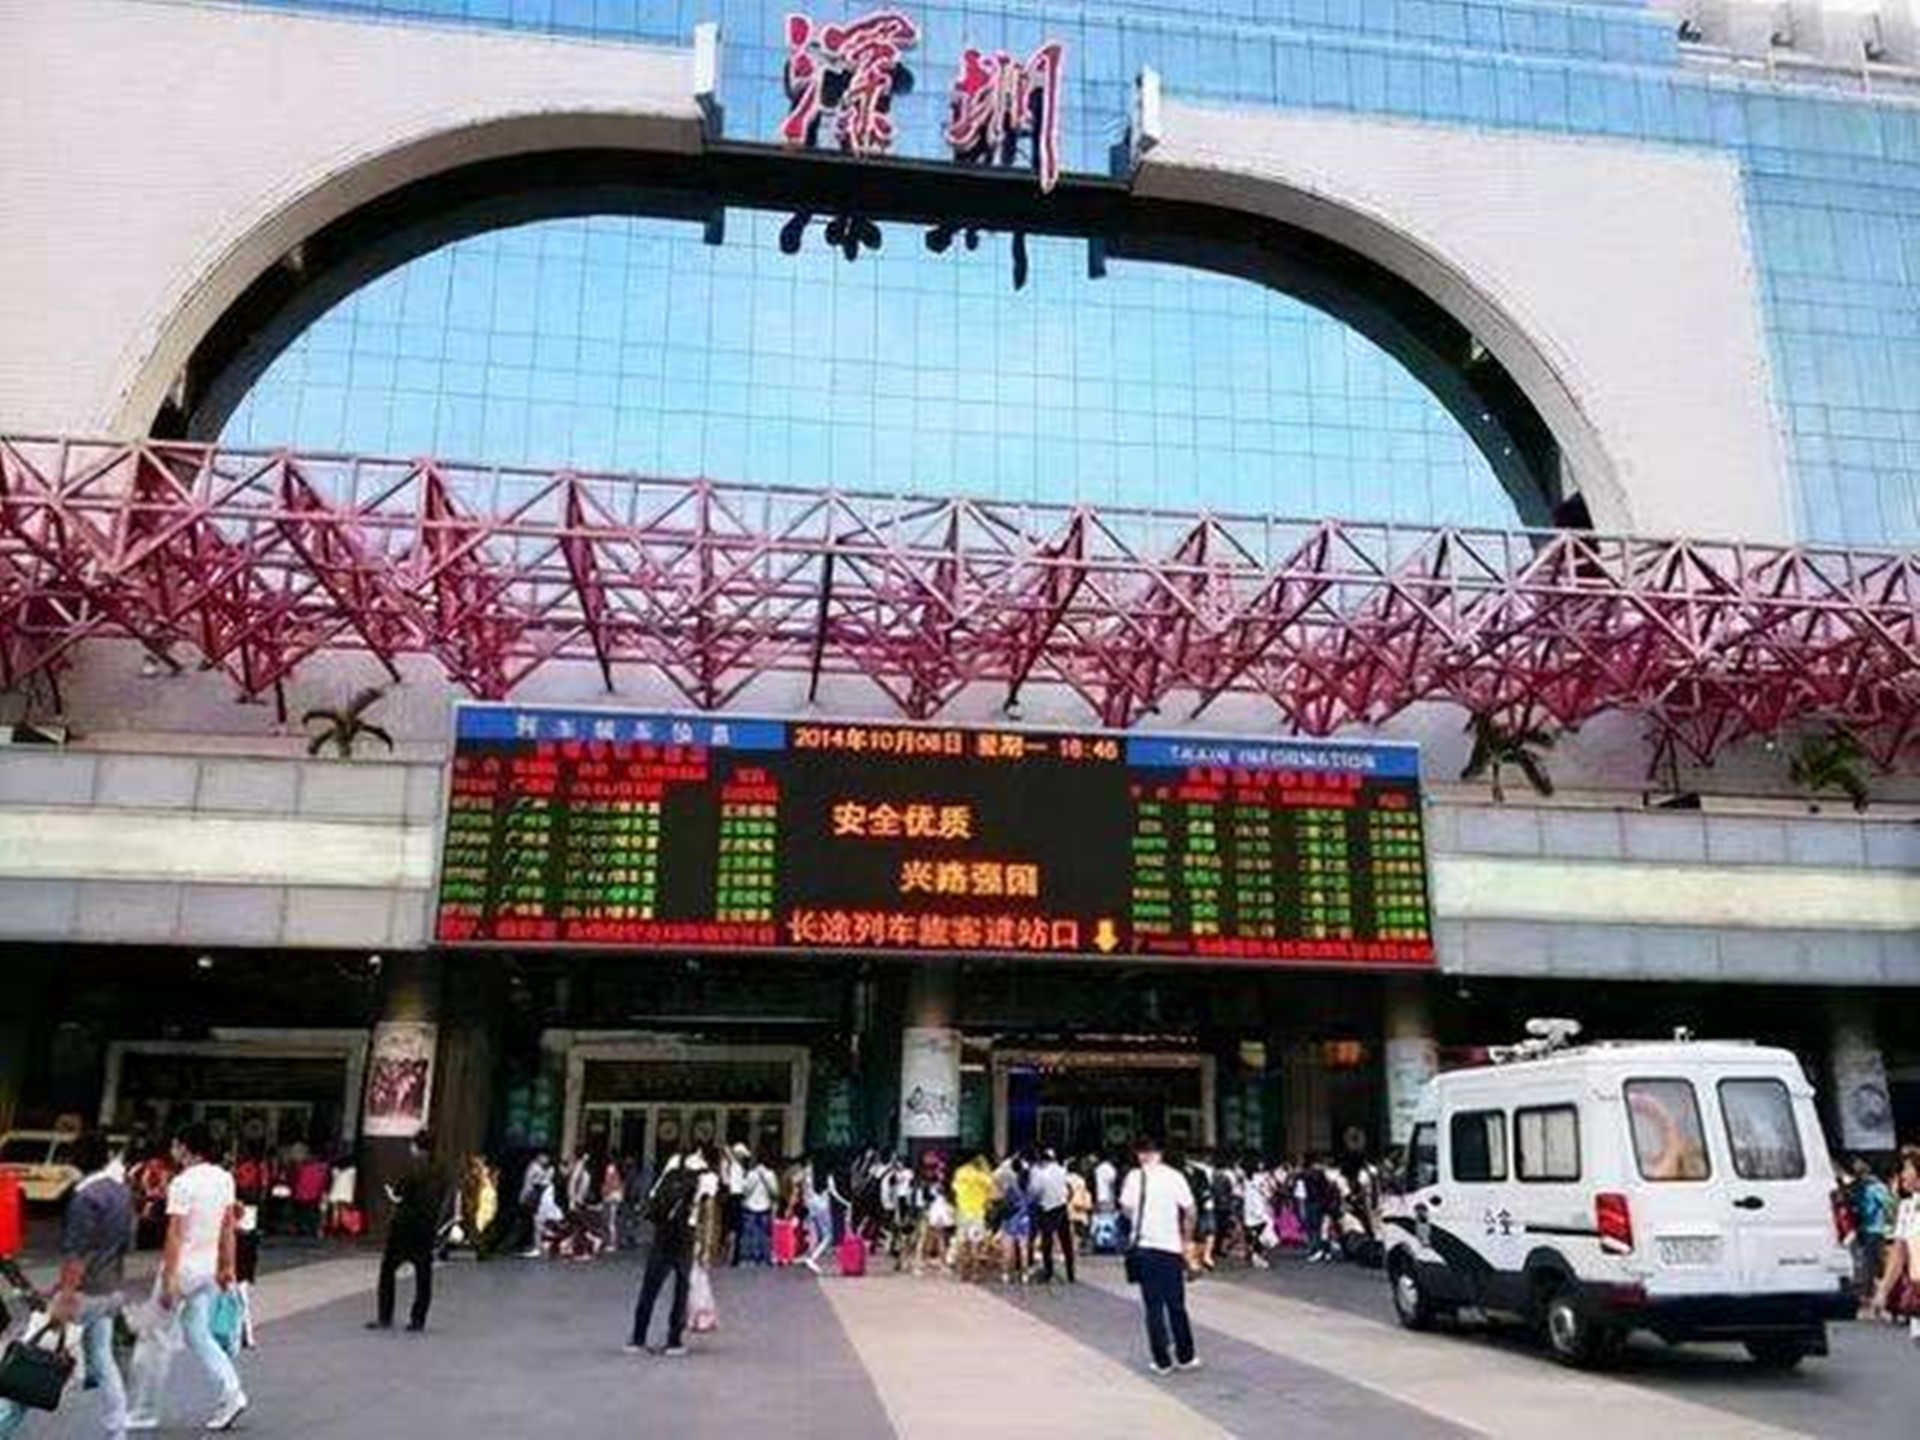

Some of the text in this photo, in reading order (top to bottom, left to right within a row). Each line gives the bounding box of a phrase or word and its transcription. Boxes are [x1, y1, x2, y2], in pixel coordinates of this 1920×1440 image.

[782, 13, 1063, 194] 深圳
[832, 801, 972, 839] 安全优质
